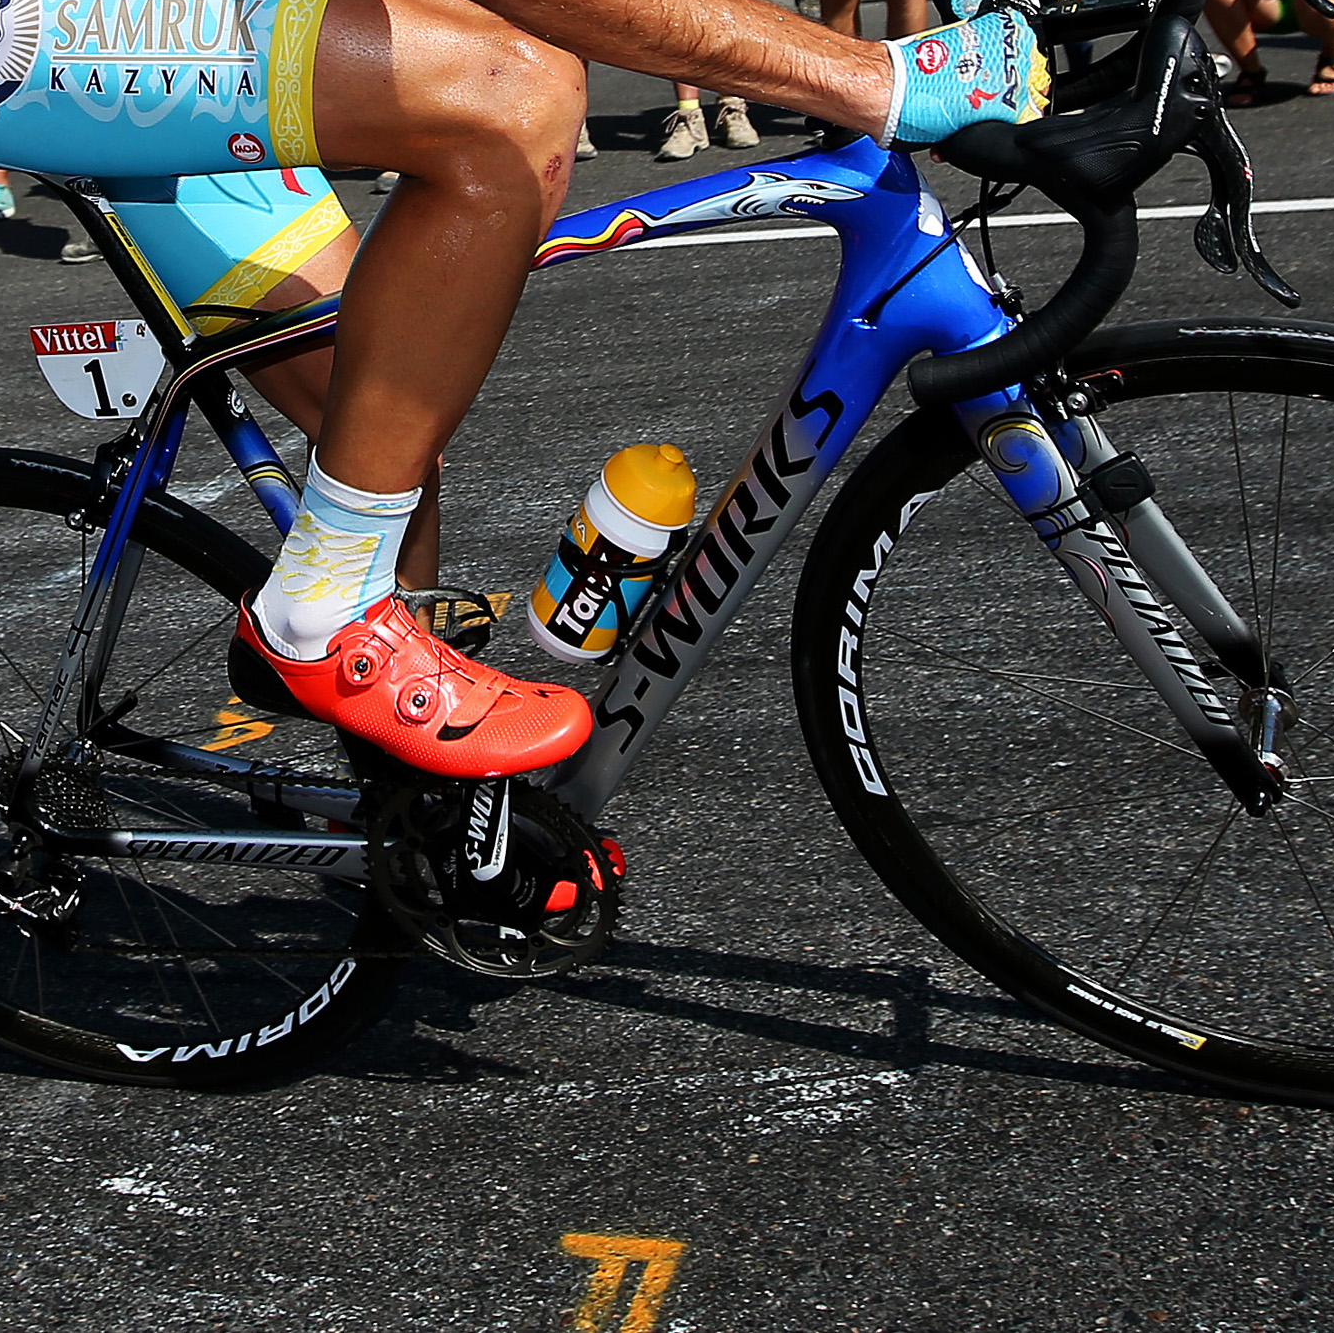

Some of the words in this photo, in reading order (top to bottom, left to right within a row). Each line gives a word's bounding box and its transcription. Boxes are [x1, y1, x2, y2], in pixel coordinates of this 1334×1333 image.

[49, 66, 255, 96] KAZYNA
[1152, 56, 1177, 136] CAMPAGNOLO
[234, 143, 260, 155] MOA
[33, 324, 108, 352] Vittel
[83, 358, 119, 417] 1
[595, 382, 845, 753] S-WORKS
[836, 487, 943, 798] CORIMA
[1081, 529, 1236, 727] PECIALIZED
[30, 667, 69, 760] Tarmac
[125, 839, 349, 867] SPECIALIZED
[493, 832, 505, 867] S-WORKS
[116, 956, 357, 1063] CORIMA
[1067, 984, 1103, 1005] FRANCE
